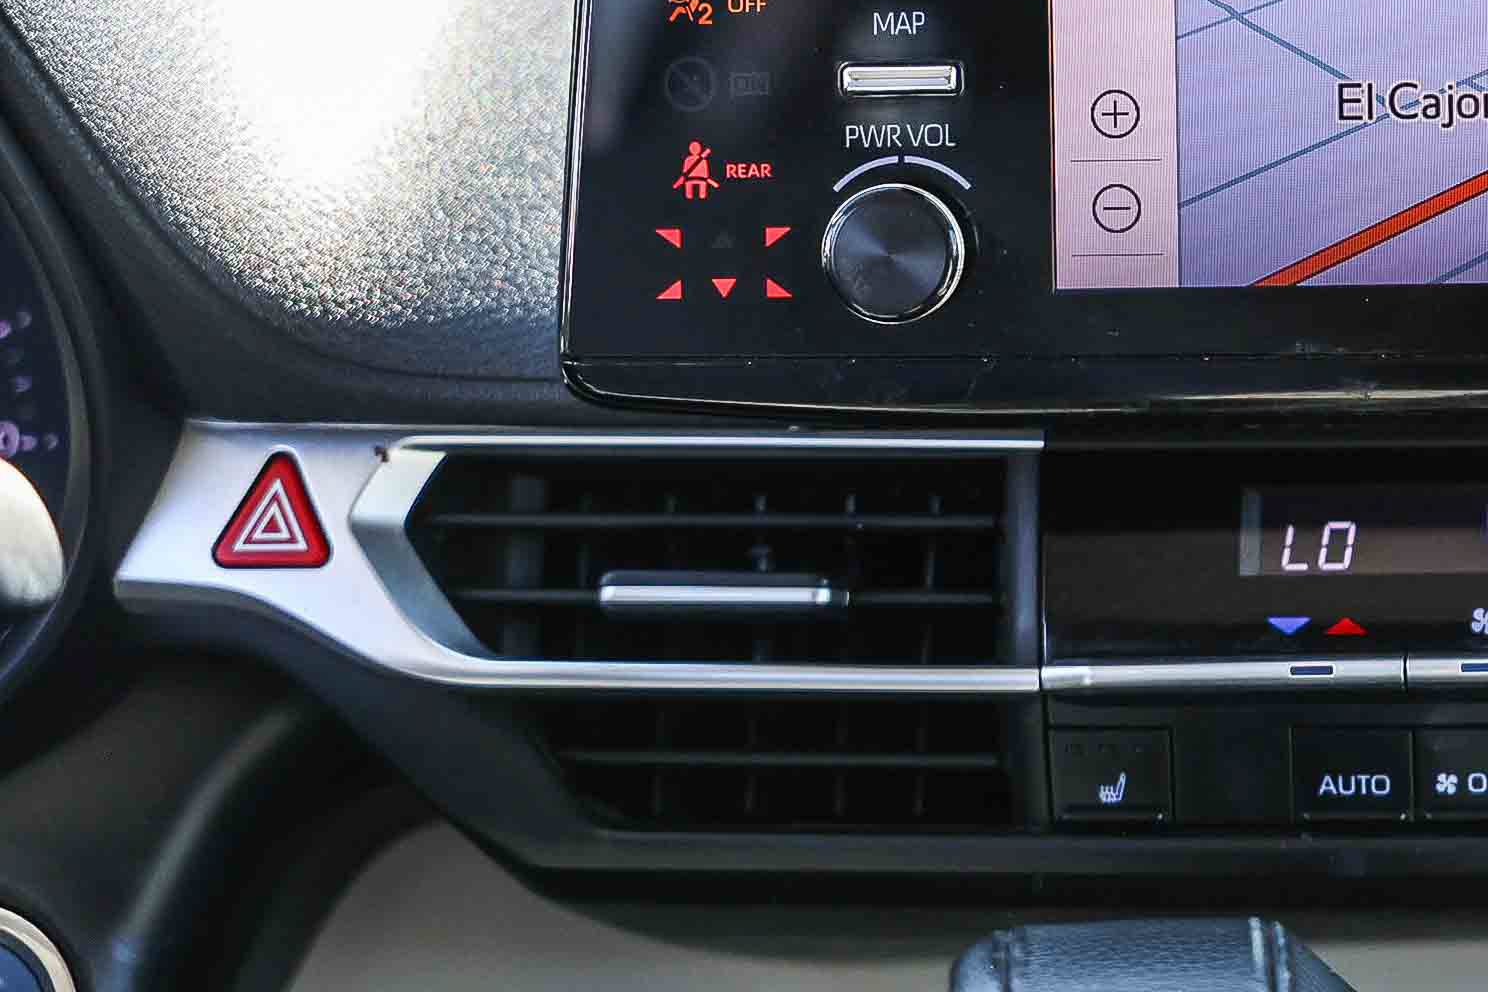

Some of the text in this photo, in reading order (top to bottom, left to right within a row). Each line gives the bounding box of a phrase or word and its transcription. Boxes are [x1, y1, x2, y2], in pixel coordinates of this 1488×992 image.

[873, 11, 925, 36] MAP
[1337, 82, 1376, 122] El
[845, 123, 956, 148] PWR VOL
[725, 163, 772, 179] REAR
[1319, 774, 1391, 796] AUTO
